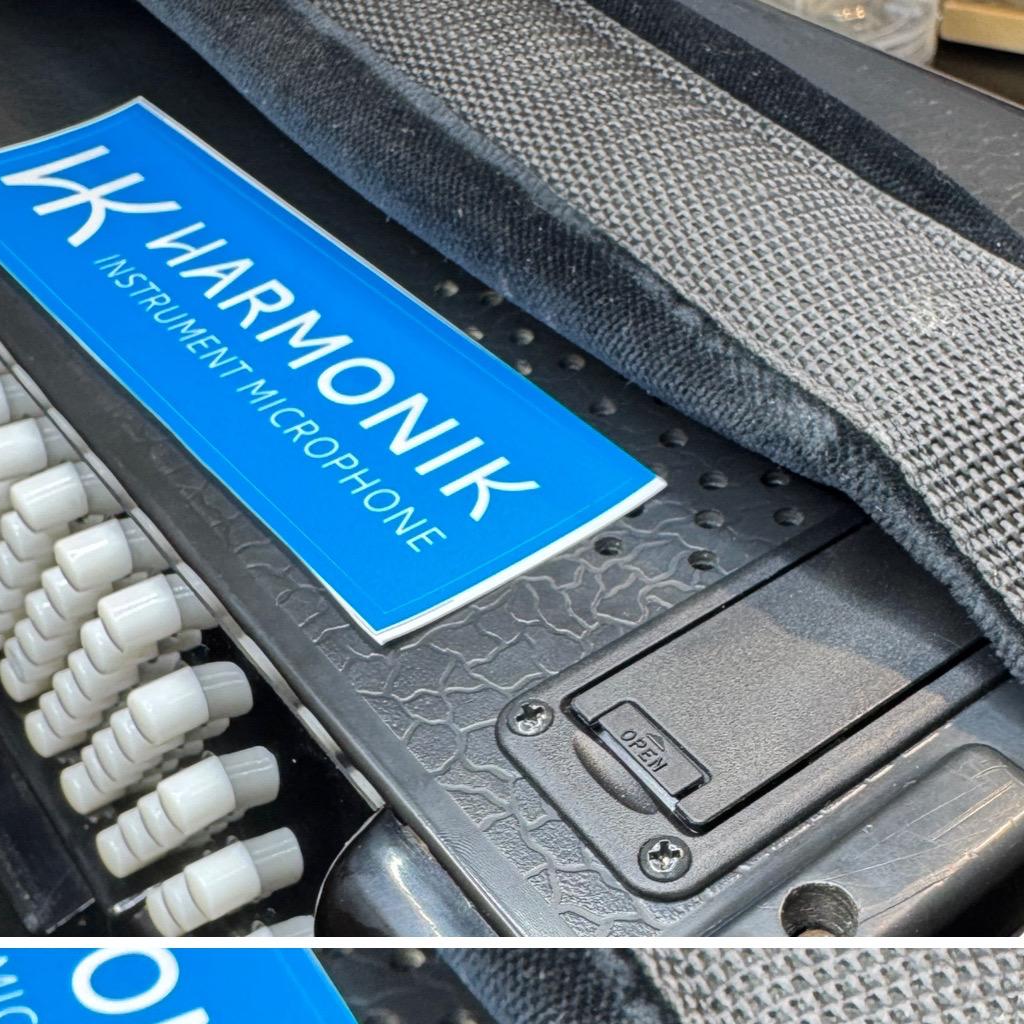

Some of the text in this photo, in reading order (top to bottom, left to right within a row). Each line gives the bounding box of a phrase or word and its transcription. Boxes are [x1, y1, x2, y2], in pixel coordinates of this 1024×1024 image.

[93, 253, 449, 554] INSTRUMENT MICROPHONE
[145, 222, 540, 522] HARMONIK
[620, 729, 668, 773] OPEN
